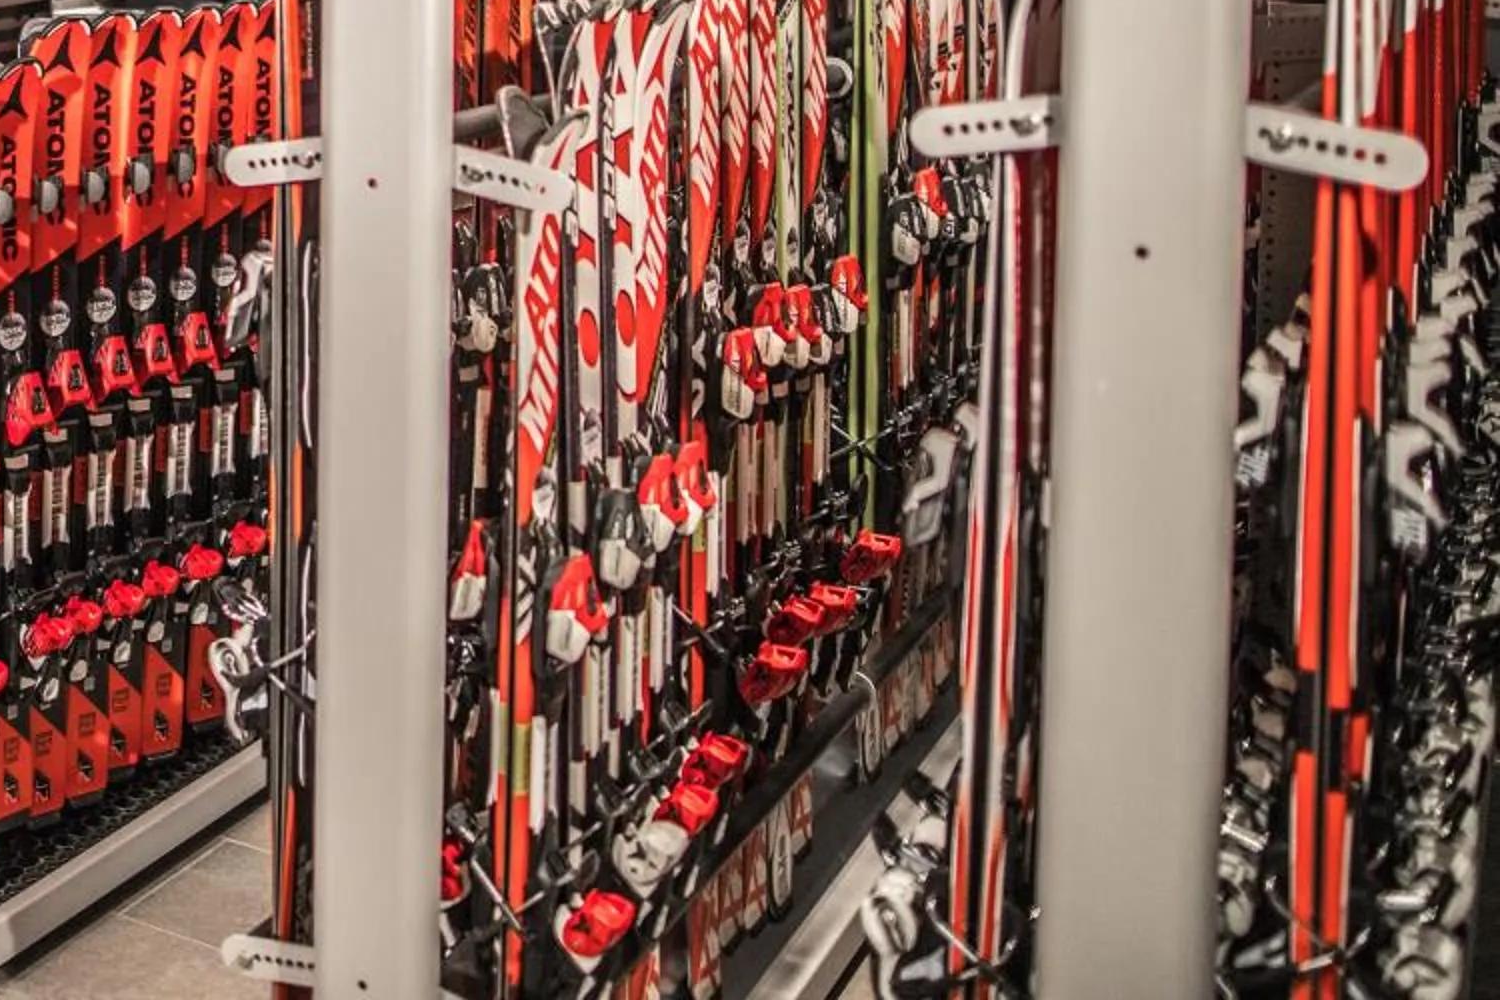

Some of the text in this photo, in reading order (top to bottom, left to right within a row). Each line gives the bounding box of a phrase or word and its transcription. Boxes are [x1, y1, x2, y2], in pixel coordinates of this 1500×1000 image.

[46, 90, 65, 225] ATOMC
[93, 83, 111, 215] ATOMC
[137, 78, 156, 207] ATOC
[179, 72, 196, 198] ATOC
[255, 57, 271, 135] ATOM
[1, 134, 18, 261] ATOIC
